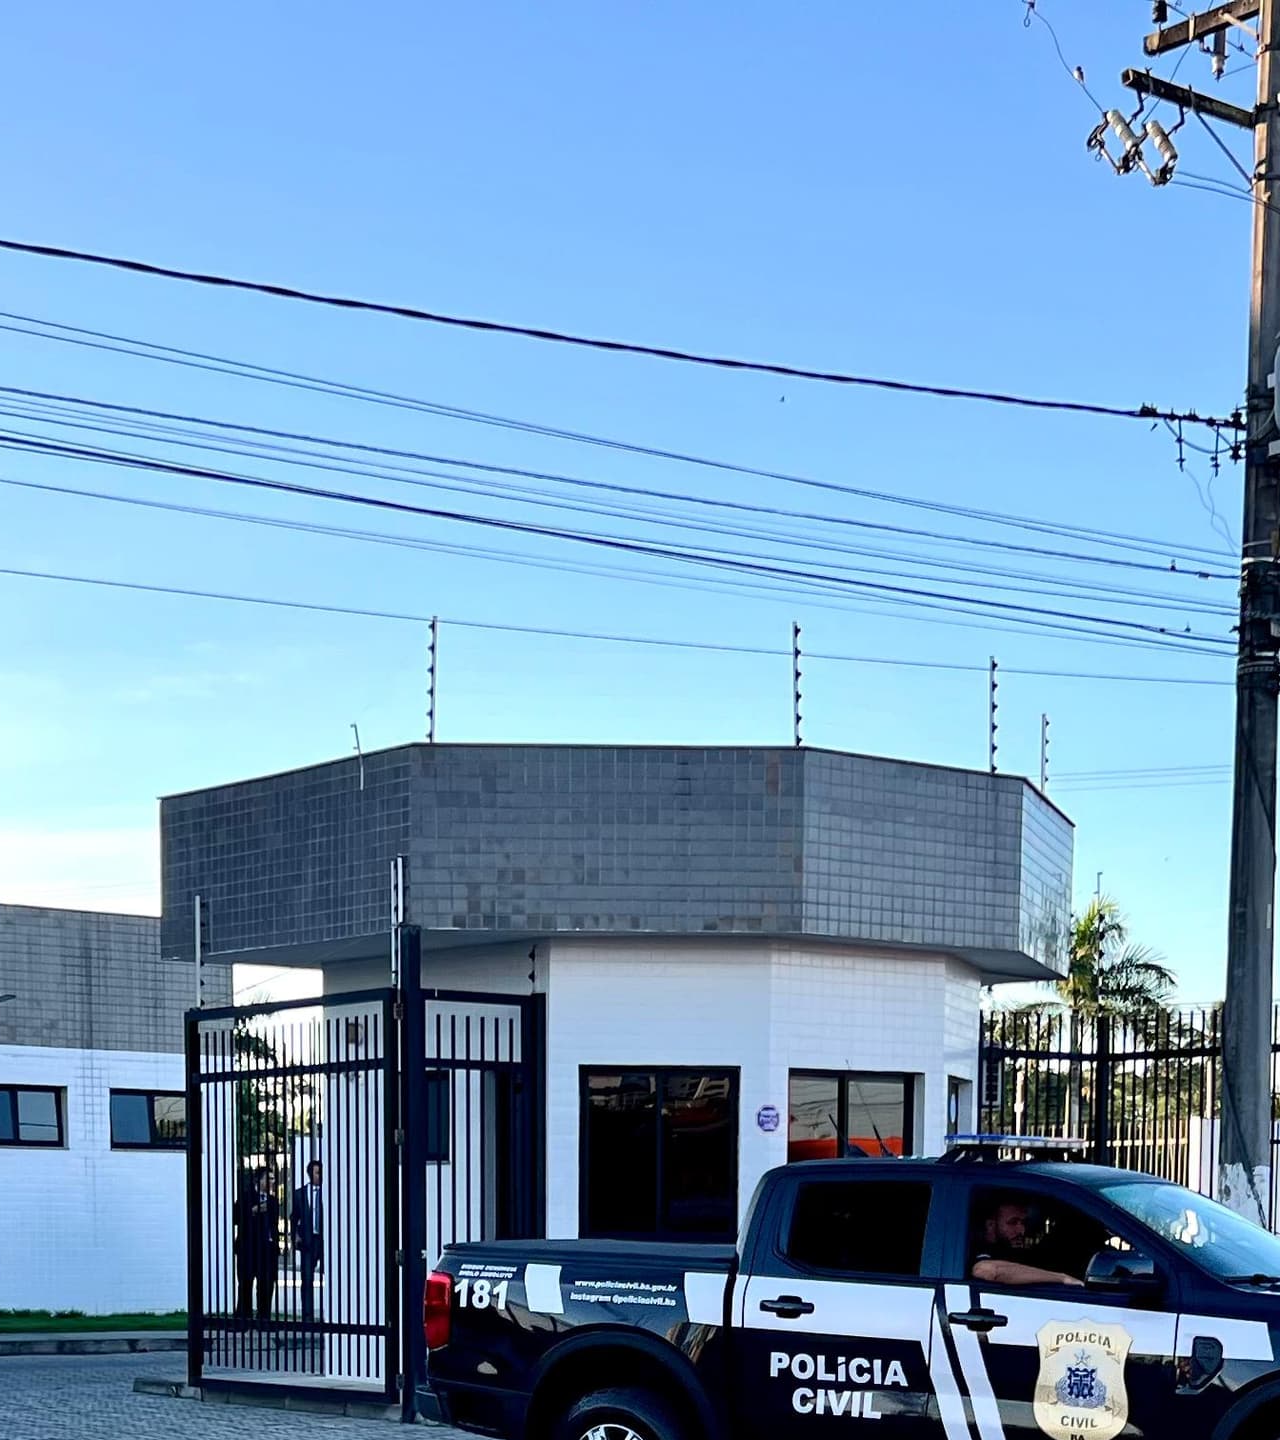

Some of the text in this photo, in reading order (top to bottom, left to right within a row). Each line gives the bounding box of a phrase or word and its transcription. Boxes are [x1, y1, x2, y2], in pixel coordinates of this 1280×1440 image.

[454, 1278, 509, 1310] 181
[792, 1387, 881, 1420] CIVIL
[1060, 1415, 1099, 1429] CIVIL
